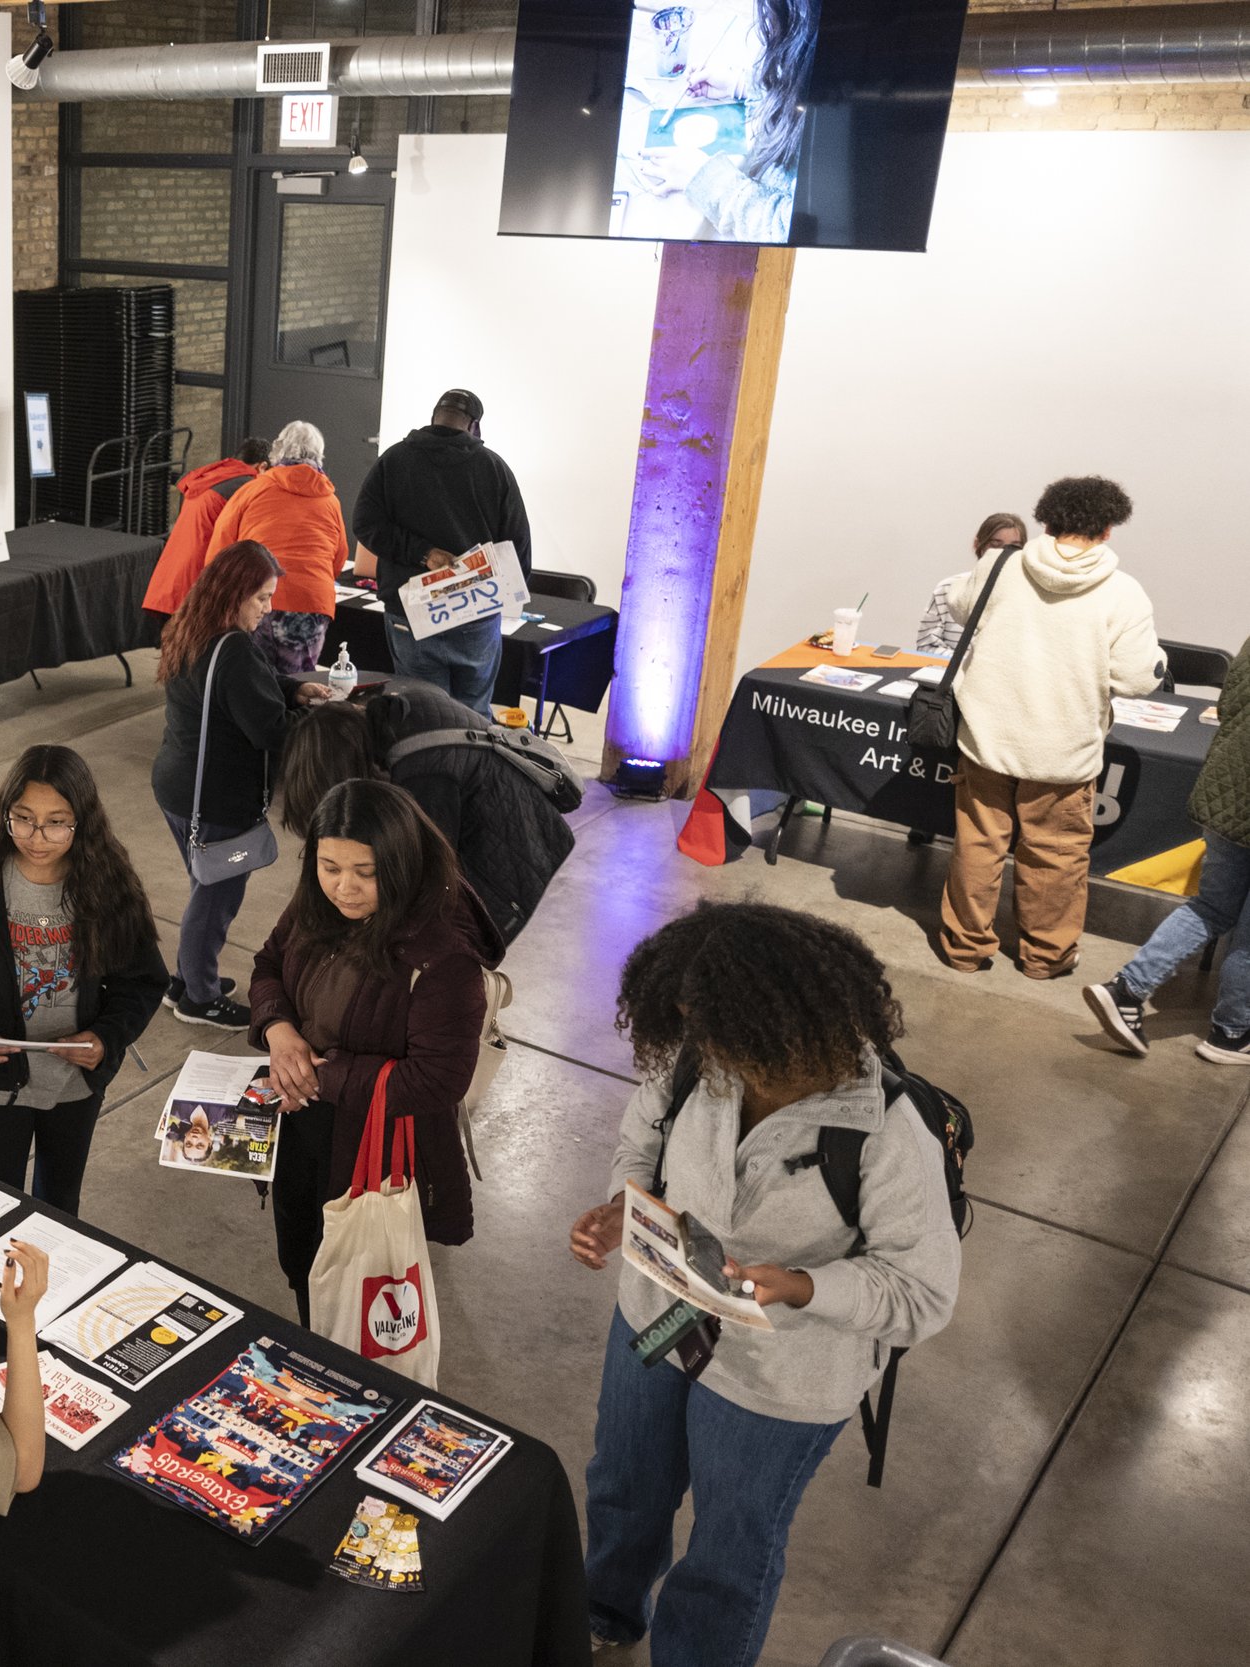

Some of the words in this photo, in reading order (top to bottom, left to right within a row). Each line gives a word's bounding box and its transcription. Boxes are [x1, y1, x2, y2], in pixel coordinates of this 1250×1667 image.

[290, 102, 324, 132] EXIT
[752, 691, 880, 739] Milwaukee
[859, 747, 902, 773] Art
[908, 757, 926, 779] &
[12, 909, 66, 925] AMAING
[249, 1141, 268, 1152] STAR
[103, 1361, 123, 1374] TEEN
[71, 1381, 116, 1412] Council
[73, 1392, 100, 1411] Teen
[219, 1437, 241, 1451] NIGHT!
[240, 1448, 255, 1459] TEEN
[153, 1452, 249, 1510] EXUBERUS
